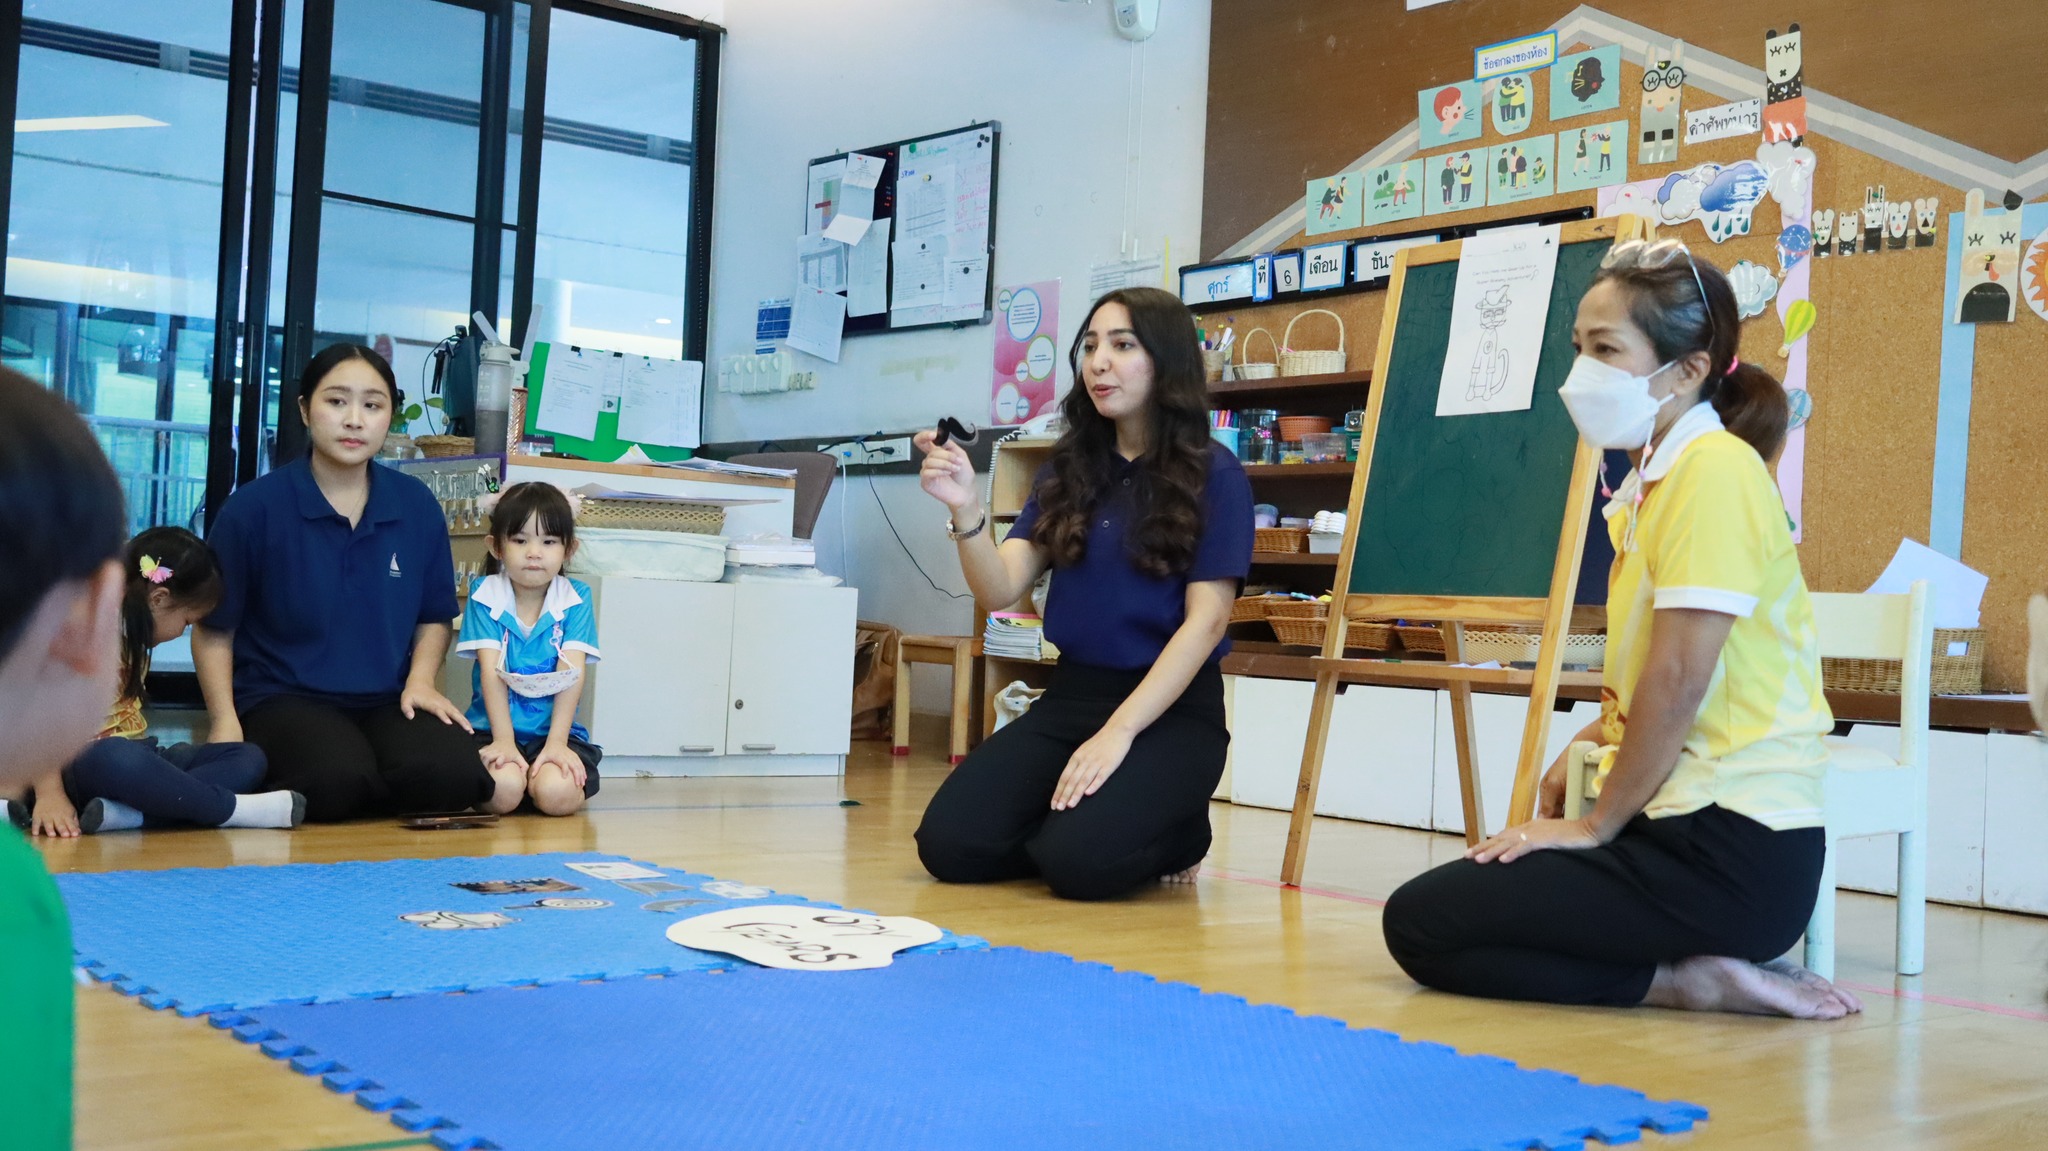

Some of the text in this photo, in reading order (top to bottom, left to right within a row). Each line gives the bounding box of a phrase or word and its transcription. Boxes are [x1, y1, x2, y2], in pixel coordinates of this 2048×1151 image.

[1207, 275, 1231, 300] ศุกร์
[1257, 258, 1267, 284] ที่
[1283, 269, 1293, 286] 6
[1309, 254, 1338, 274] เดือน
[812, 915, 912, 938] SPY
